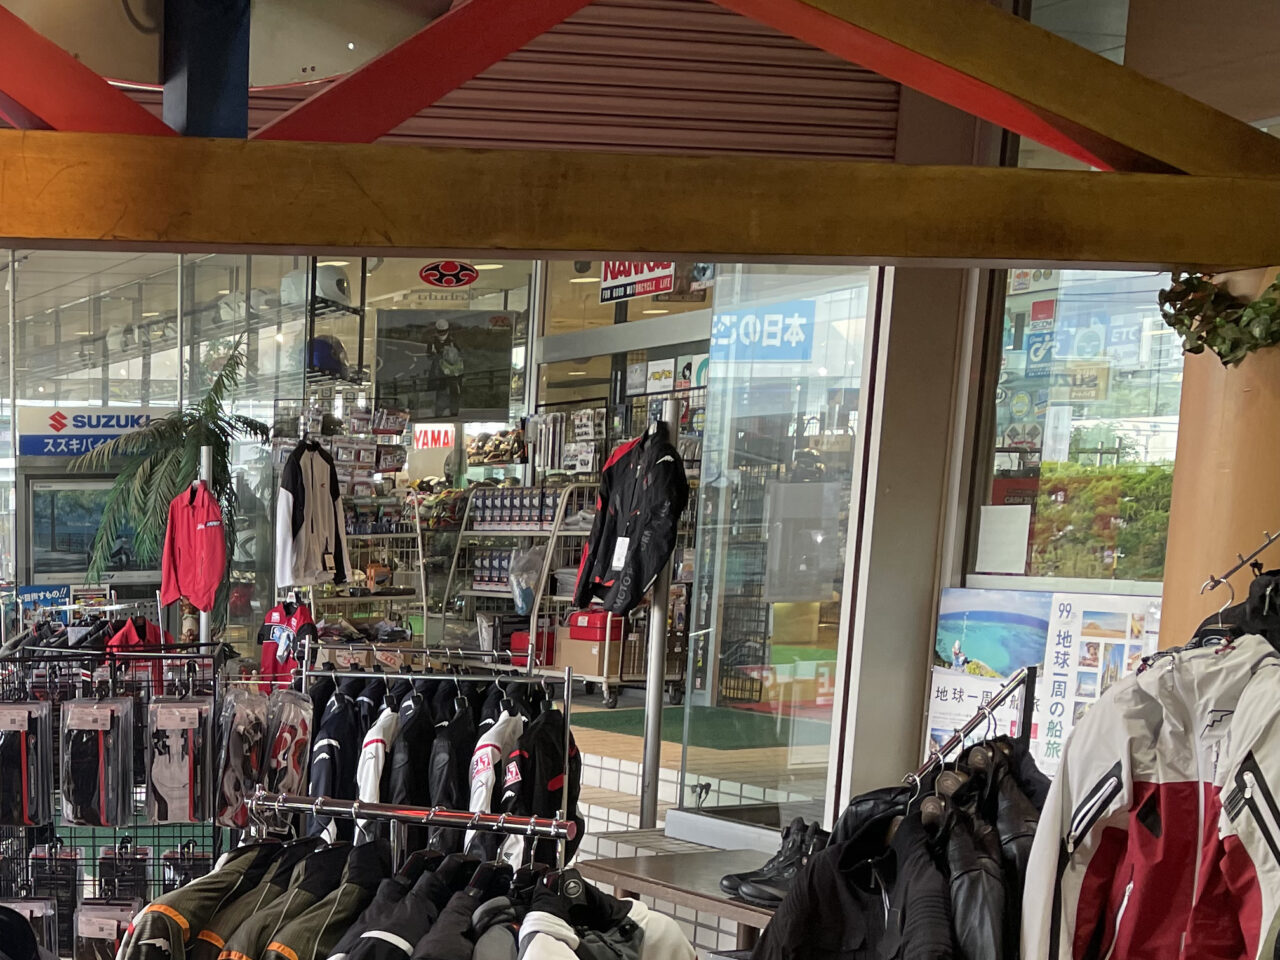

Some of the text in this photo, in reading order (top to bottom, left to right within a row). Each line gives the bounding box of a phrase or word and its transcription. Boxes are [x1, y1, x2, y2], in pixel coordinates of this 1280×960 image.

[73, 414, 151, 429] SUZUKI
[1044, 629, 1073, 759] 地球一周の船旅
